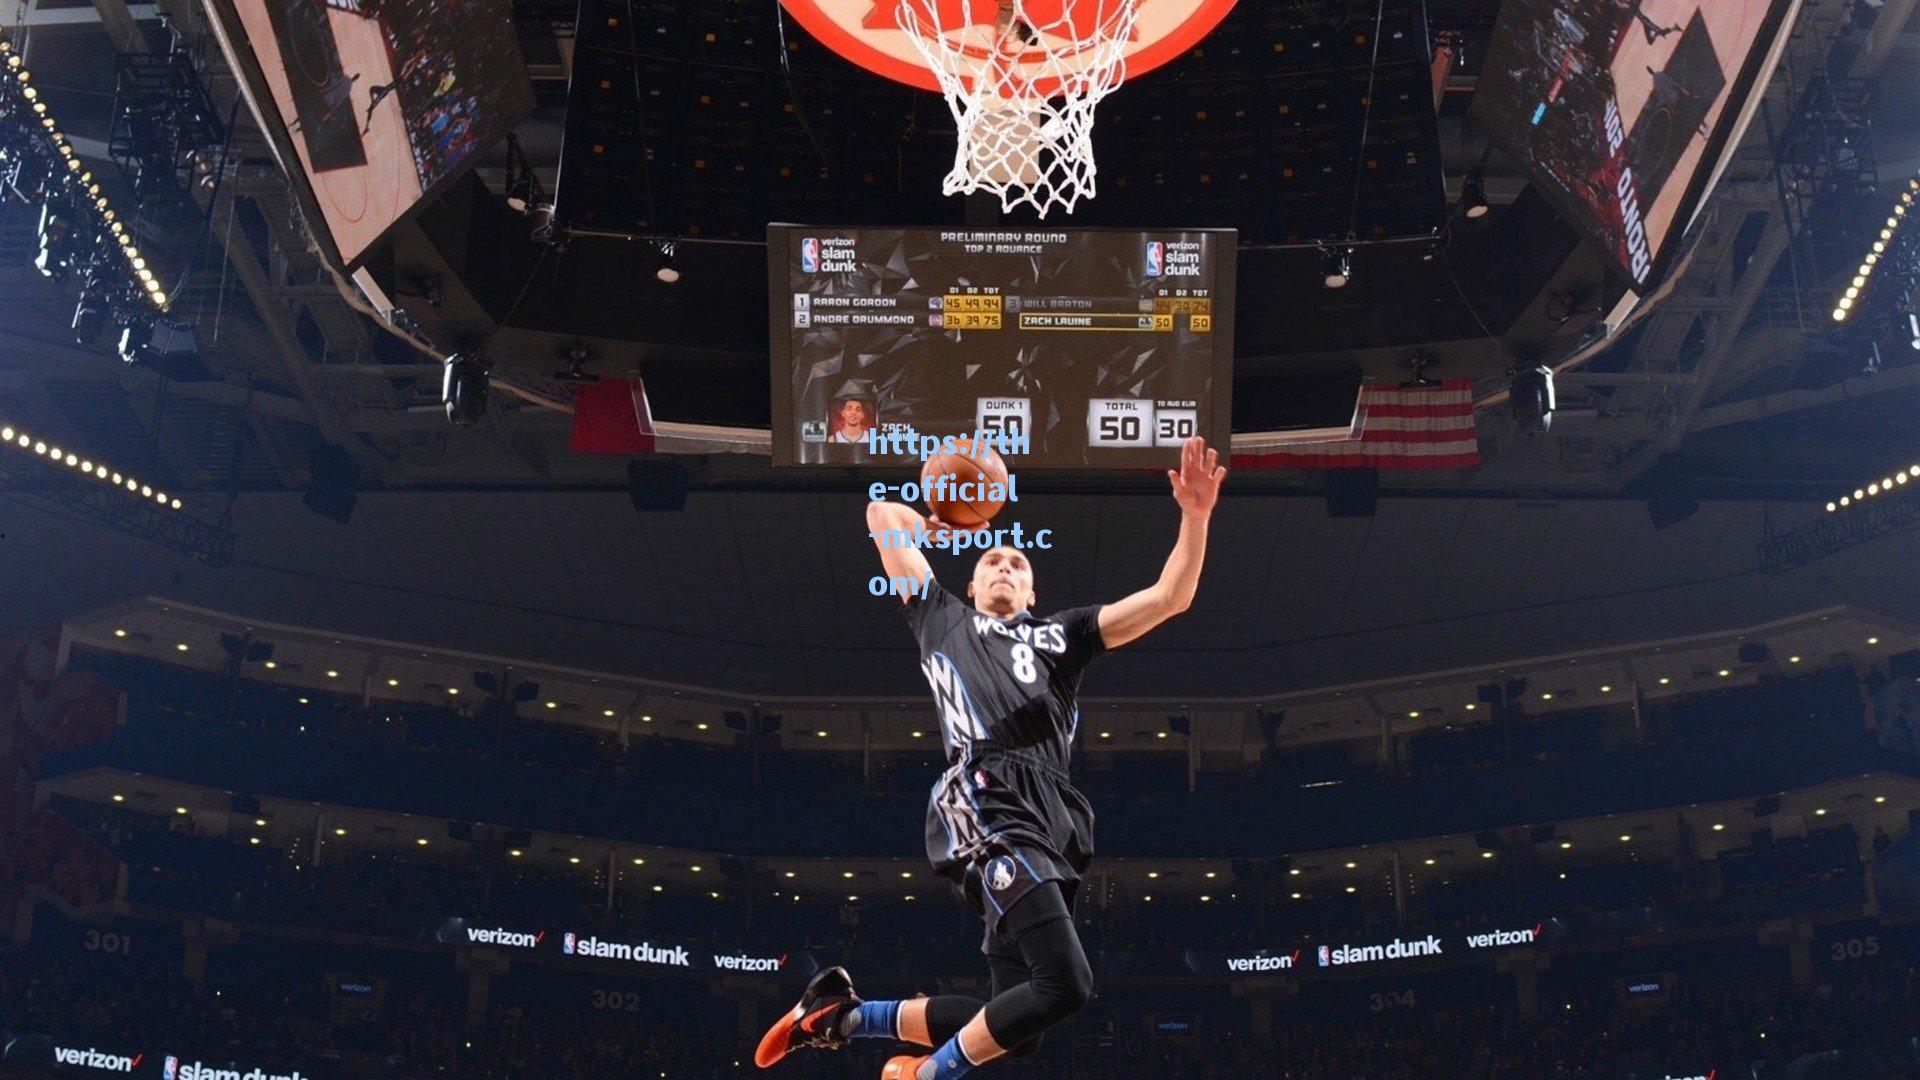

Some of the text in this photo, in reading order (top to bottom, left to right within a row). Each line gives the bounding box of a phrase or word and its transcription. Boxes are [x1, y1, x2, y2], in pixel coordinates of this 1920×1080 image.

[821, 238, 855, 246] verizon
[940, 232, 1067, 243] PRELIMINARY ROUND
[965, 244, 984, 253] TOP
[1166, 241, 1200, 250] verizon
[821, 246, 856, 259] slam
[1166, 250, 1200, 263] slam
[821, 260, 857, 272] dunk
[1165, 263, 1200, 276] dunk
[813, 298, 850, 307] AARON
[853, 299, 896, 307] GORDON
[946, 299, 999, 308] 45 49 94
[1024, 300, 1047, 309] WILL
[1050, 300, 1092, 309] BARTON
[799, 315, 915, 324] 2 ANDRE DRUMMOND
[966, 316, 980, 325] 39
[984, 316, 999, 326] 75
[1024, 317, 1052, 325] ZACH
[1156, 318, 1170, 327] 50
[1193, 318, 1208, 327] 50
[986, 401, 1015, 409] DUNK
[1105, 402, 1138, 411] TOTAL
[1100, 416, 1141, 441] 50
[1160, 418, 1193, 438] 30
[1011, 643, 1037, 684] 8
[85, 930, 131, 955] 301
[467, 928, 536, 948] verizon
[1467, 929, 1535, 948] verizon
[577, 936, 689, 966] slam dunk
[1331, 935, 1443, 965] slam dunk
[1831, 935, 1881, 962] 305
[714, 955, 779, 971] verizon
[1227, 955, 1292, 971] verizon
[592, 989, 640, 1011] 302
[54, 1047, 132, 1072] verizon
[179, 1061, 241, 1080] slam
